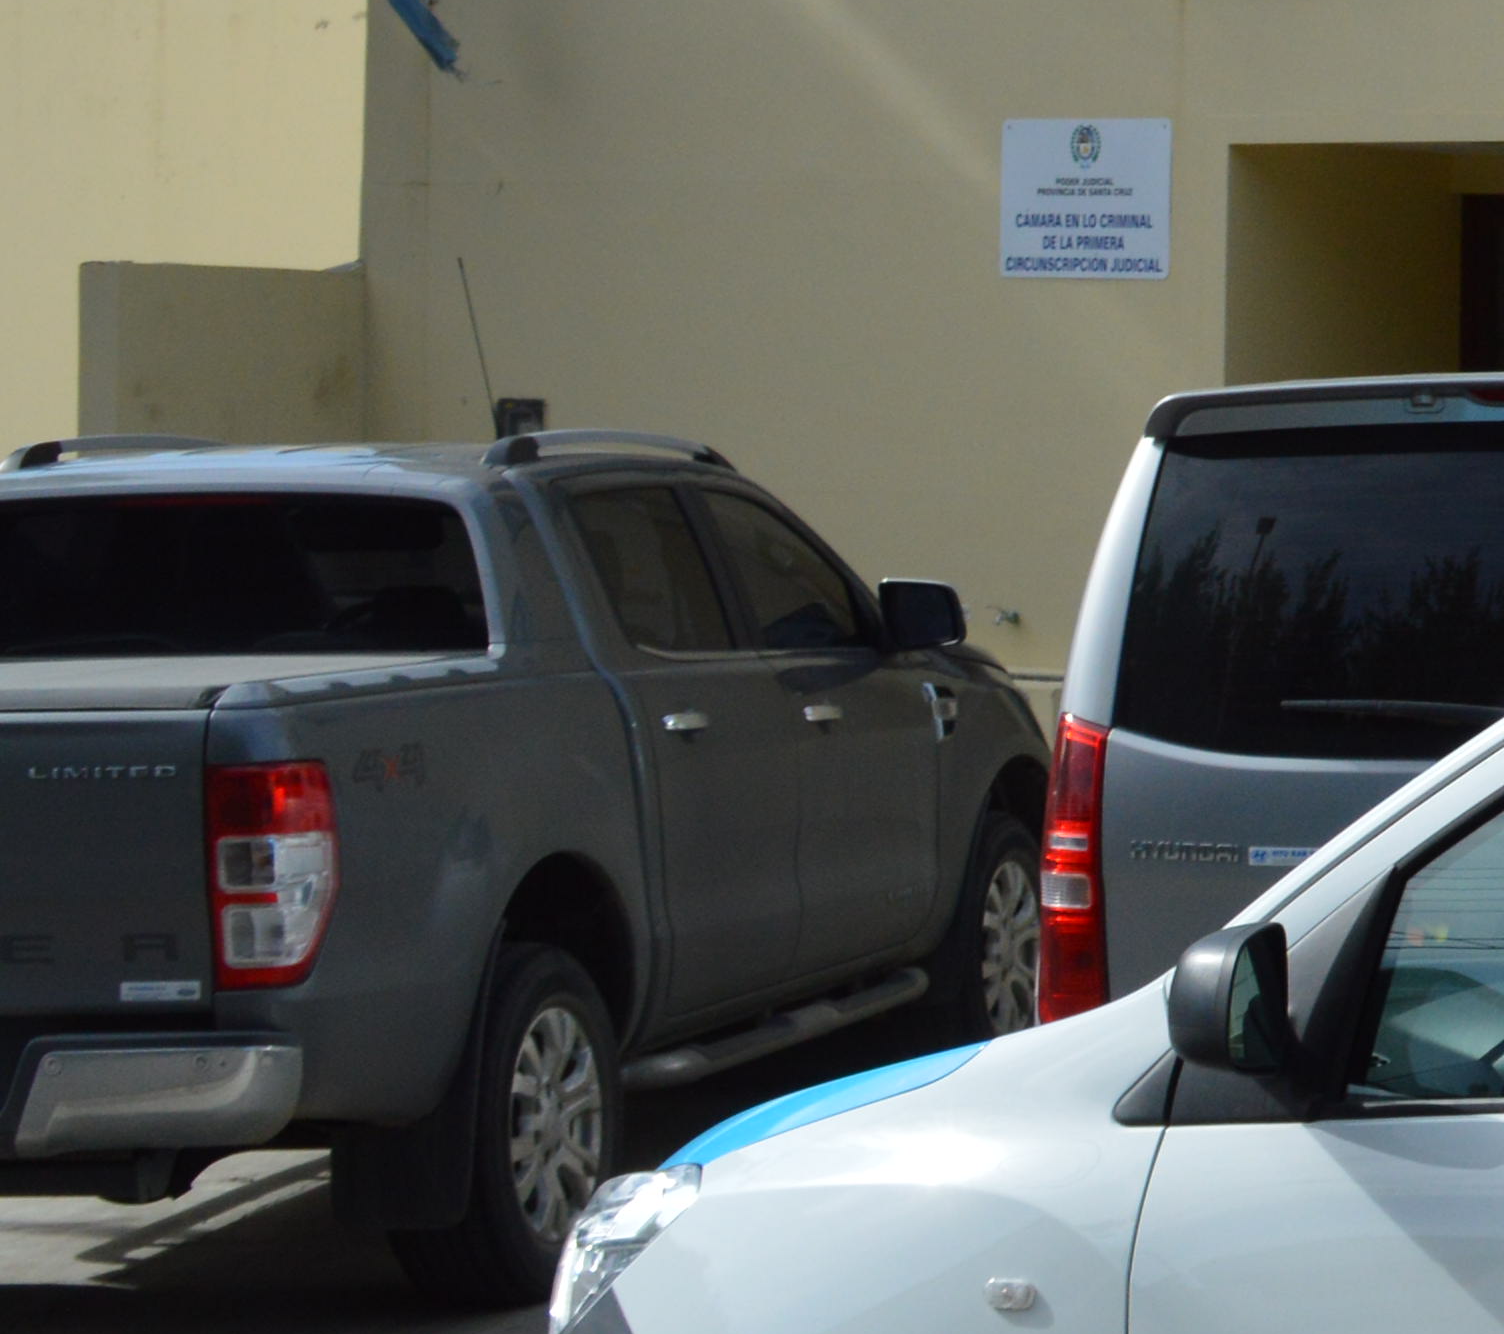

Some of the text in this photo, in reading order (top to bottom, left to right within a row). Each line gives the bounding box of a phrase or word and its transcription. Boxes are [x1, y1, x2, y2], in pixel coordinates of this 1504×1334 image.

[1081, 177, 1114, 186] JUDICIAL
[1065, 213, 1080, 228] EN
[1082, 213, 1097, 228] LO
[1099, 213, 1153, 229] CRIMINAL
[1042, 235, 1125, 250] DE LA PRIMERA
[1109, 257, 1163, 273] JUDICIAL
[28, 765, 177, 779] LIMITED
[1129, 840, 1240, 863] HYUNDAI
